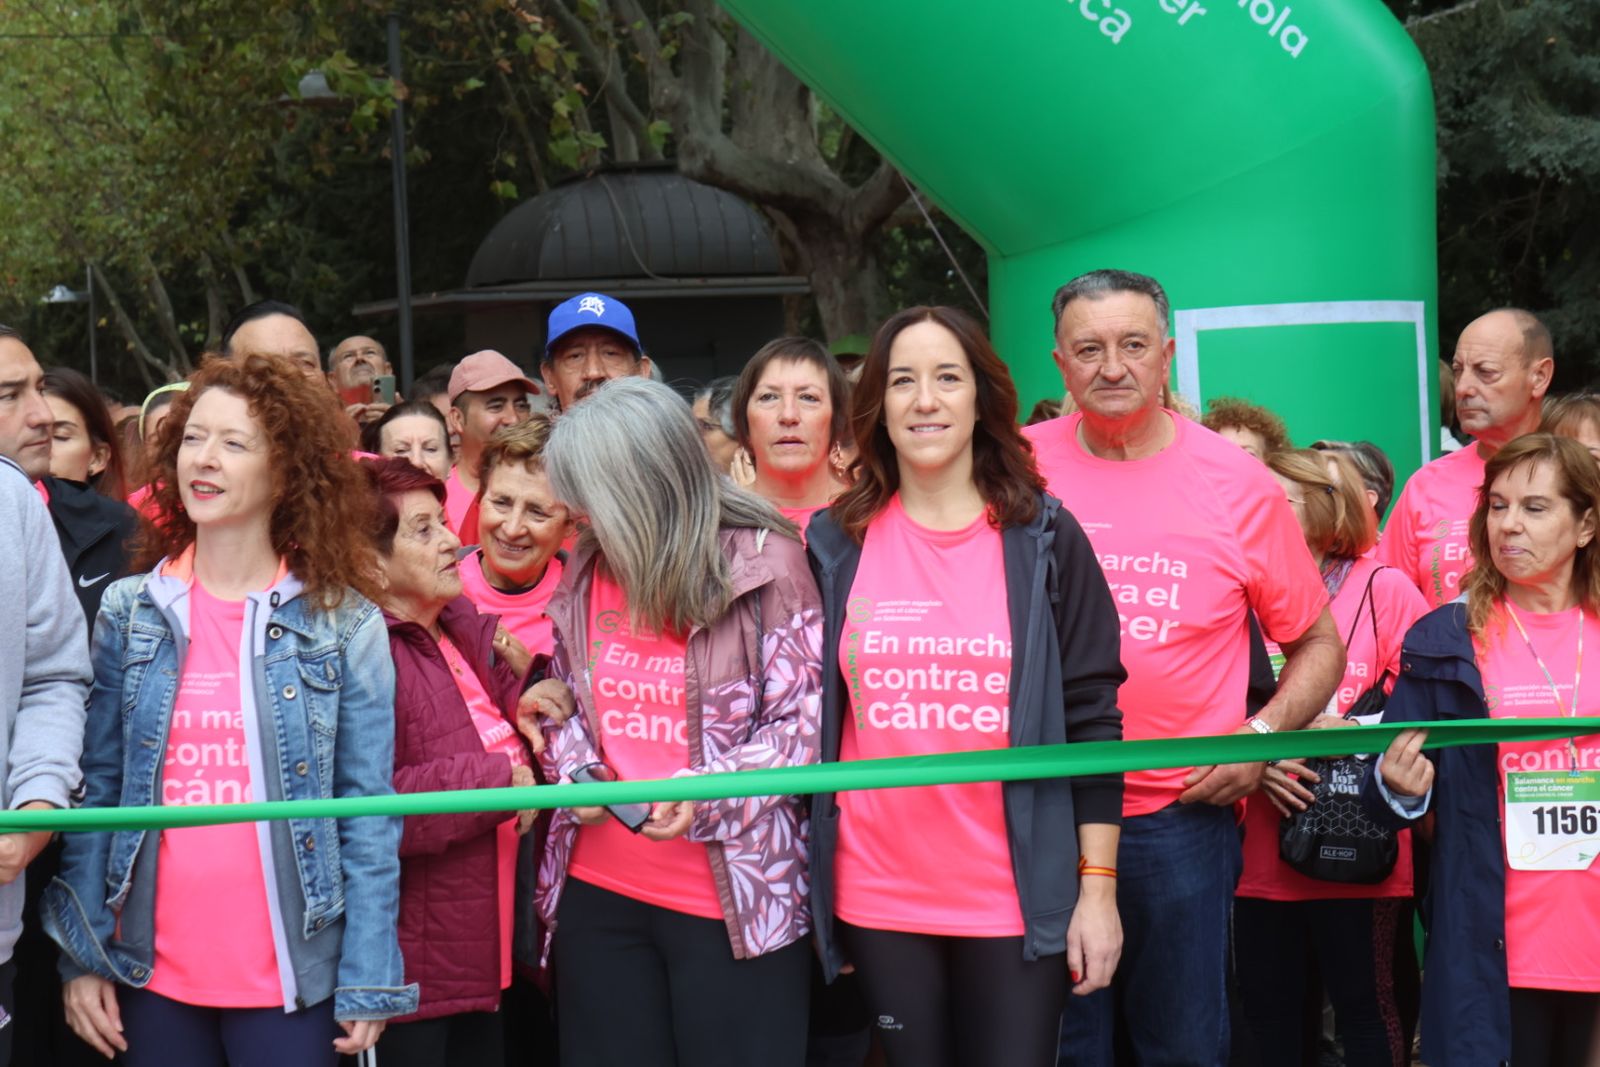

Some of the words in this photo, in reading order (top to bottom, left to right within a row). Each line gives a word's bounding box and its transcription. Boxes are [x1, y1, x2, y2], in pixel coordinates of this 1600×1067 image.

[1066, 0, 1132, 45] ca
[1237, 0, 1309, 59] ola
[1096, 551, 1188, 579] archa
[1145, 583, 1180, 610] el
[863, 631, 899, 654] En
[604, 642, 639, 668] En
[644, 655, 685, 674] ma
[598, 676, 685, 706] contr
[863, 663, 979, 692] contra
[202, 709, 244, 729] ma
[1328, 783, 1360, 797] you
[1532, 805, 1600, 835] 1156
[1323, 848, 1354, 858] ALE-HOP
